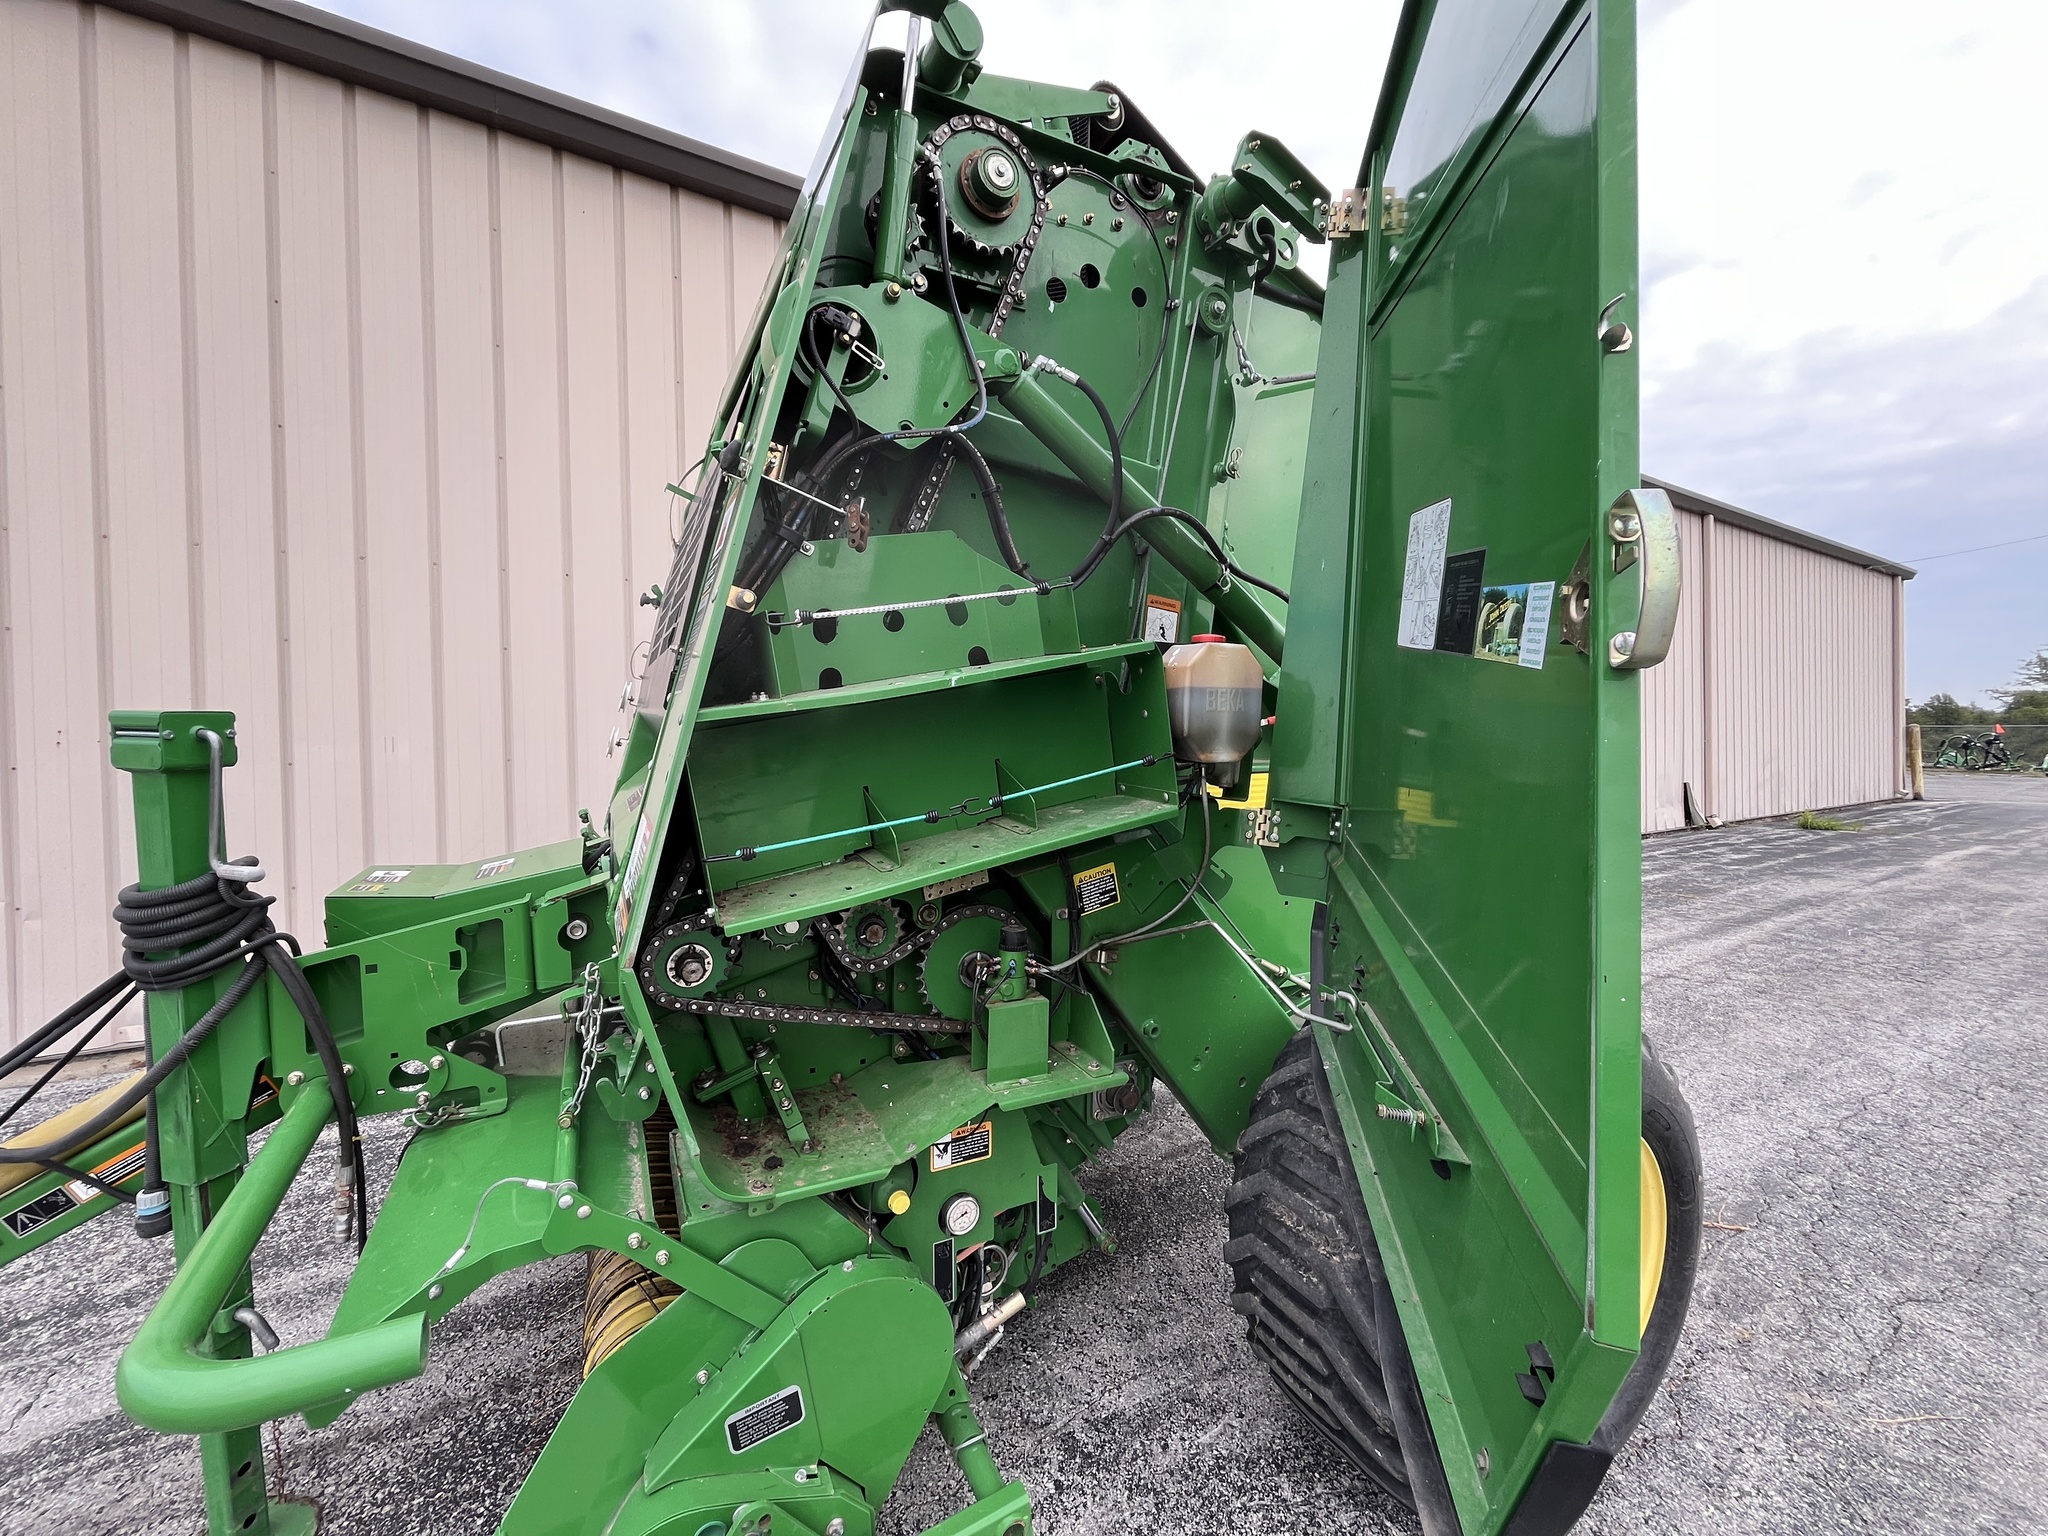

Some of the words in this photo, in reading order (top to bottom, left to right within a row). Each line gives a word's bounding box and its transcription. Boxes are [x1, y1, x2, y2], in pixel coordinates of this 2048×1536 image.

[1154, 599, 1176, 609] WARNING
[1206, 688, 1244, 711] BEKA
[1083, 868, 1112, 881] CAUTION
[960, 1123, 987, 1135] WARNG
[744, 1394, 780, 1414] IMPORTANT
